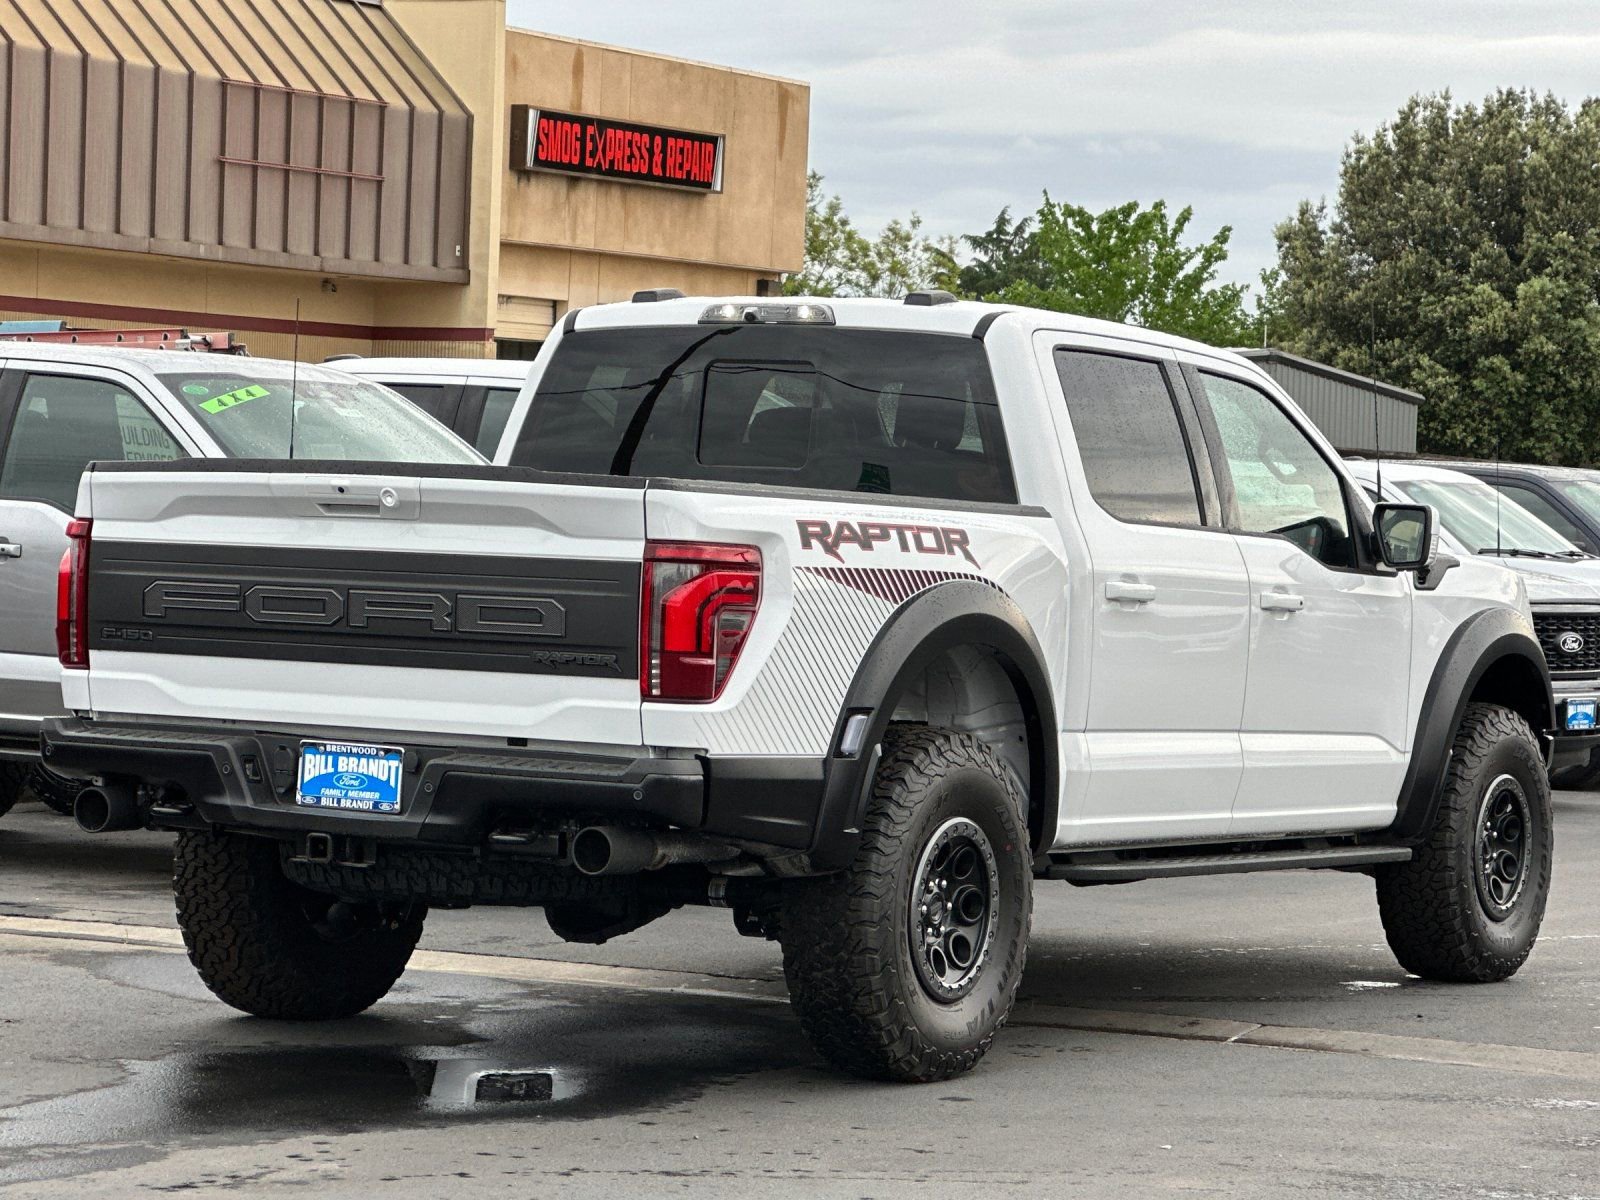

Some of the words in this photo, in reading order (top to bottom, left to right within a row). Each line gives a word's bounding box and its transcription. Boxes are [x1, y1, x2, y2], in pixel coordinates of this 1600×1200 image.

[538, 118, 581, 165] SMOG
[585, 121, 650, 174] EXPRESS
[652, 135, 663, 177] &
[666, 136, 715, 184] REPAIR
[795, 519, 981, 571] RAPTOR
[142, 579, 567, 639] FORD
[100, 627, 153, 641] F-150
[532, 650, 622, 673] RAPTOR
[325, 744, 377, 756] BRENTWOOD
[303, 753, 335, 784] BILL
[337, 756, 399, 789] BRANDT
[339, 775, 361, 787] Ford
[320, 788, 347, 798] FAMILY
[347, 790, 380, 799] MEMBER
[320, 797, 339, 807] BILL
[340, 798, 375, 810] BRANDT
